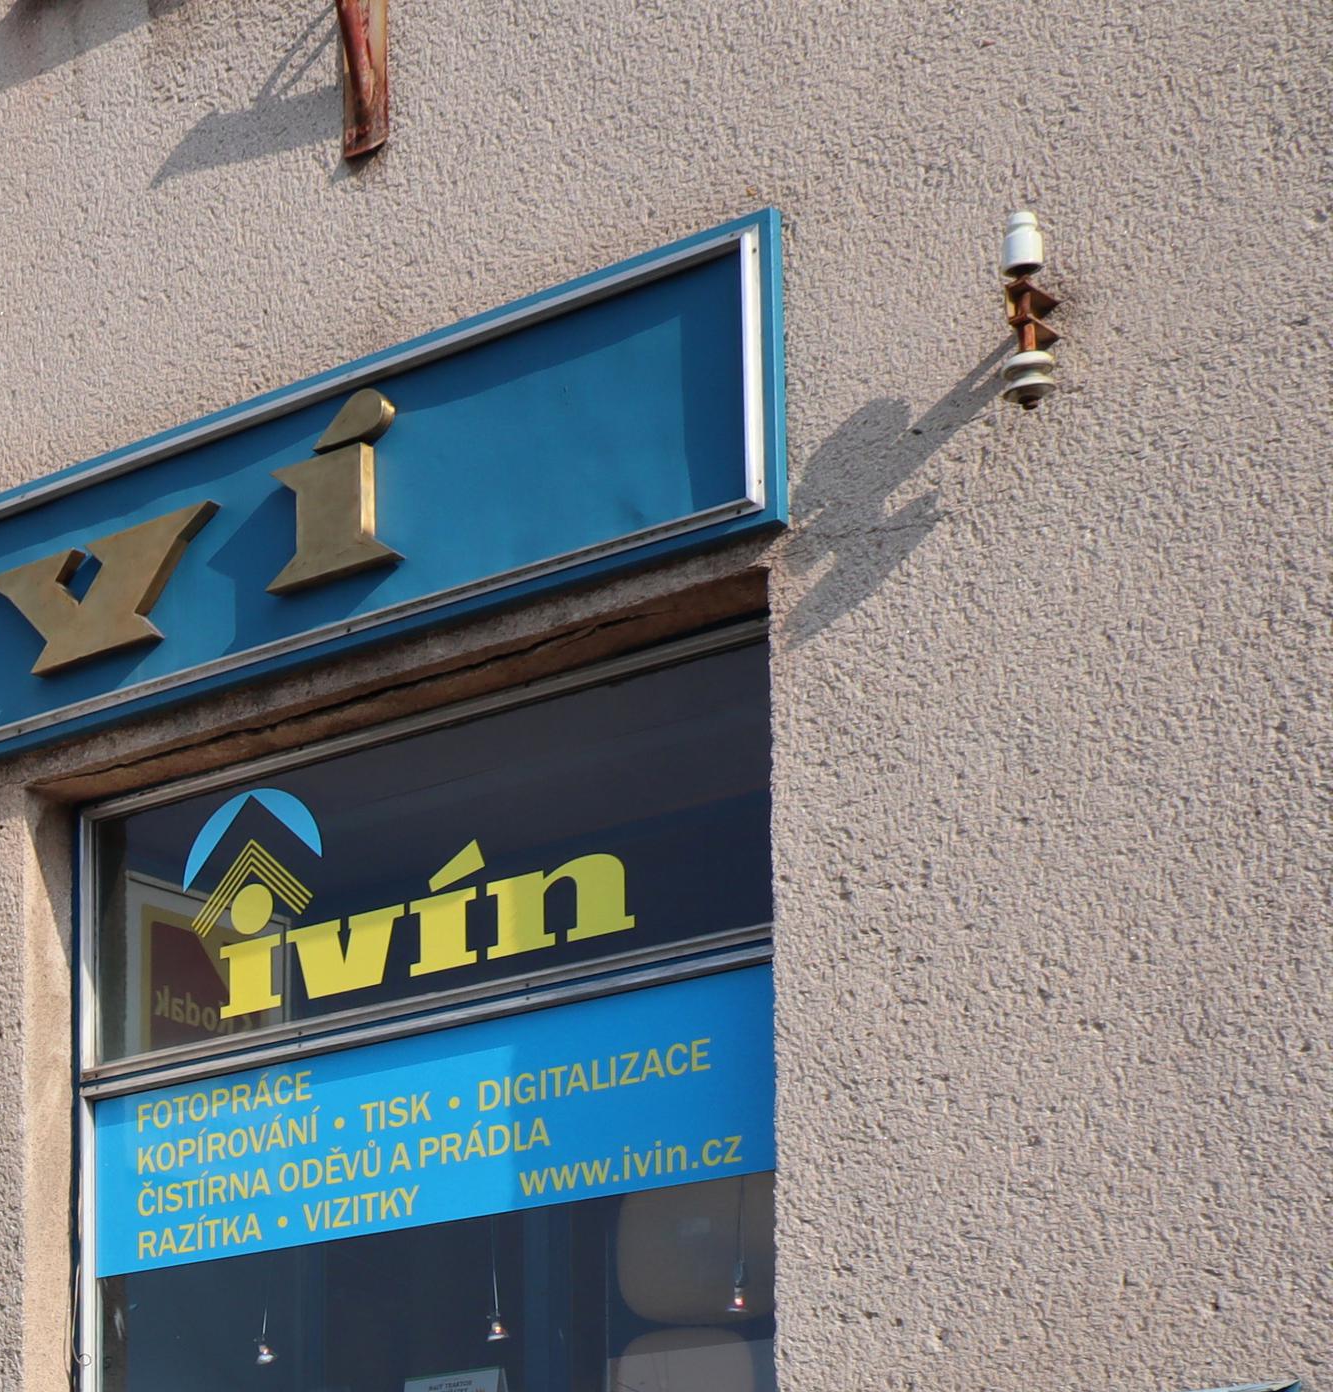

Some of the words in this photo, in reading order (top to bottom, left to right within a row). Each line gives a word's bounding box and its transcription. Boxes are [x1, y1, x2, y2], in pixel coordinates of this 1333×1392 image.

[220, 838, 636, 1020] ivín
[137, 1070, 312, 1133] FOTOPRÁCE
[137, 1105, 319, 1176] KOPÍROVÁNÍ
[361, 1091, 432, 1134] TISK
[478, 1038, 712, 1112] DIGITALIZACE
[137, 1165, 272, 1217] ČISTÍRNA
[278, 1139, 380, 1193] ODĚVŮ
[389, 1143, 413, 1172] A
[418, 1117, 550, 1168] PRÁDLA
[519, 1135, 743, 1198] www.ivin.cz
[137, 1207, 263, 1260] RAZÍTKA
[303, 1185, 420, 1233] VIZITKY
